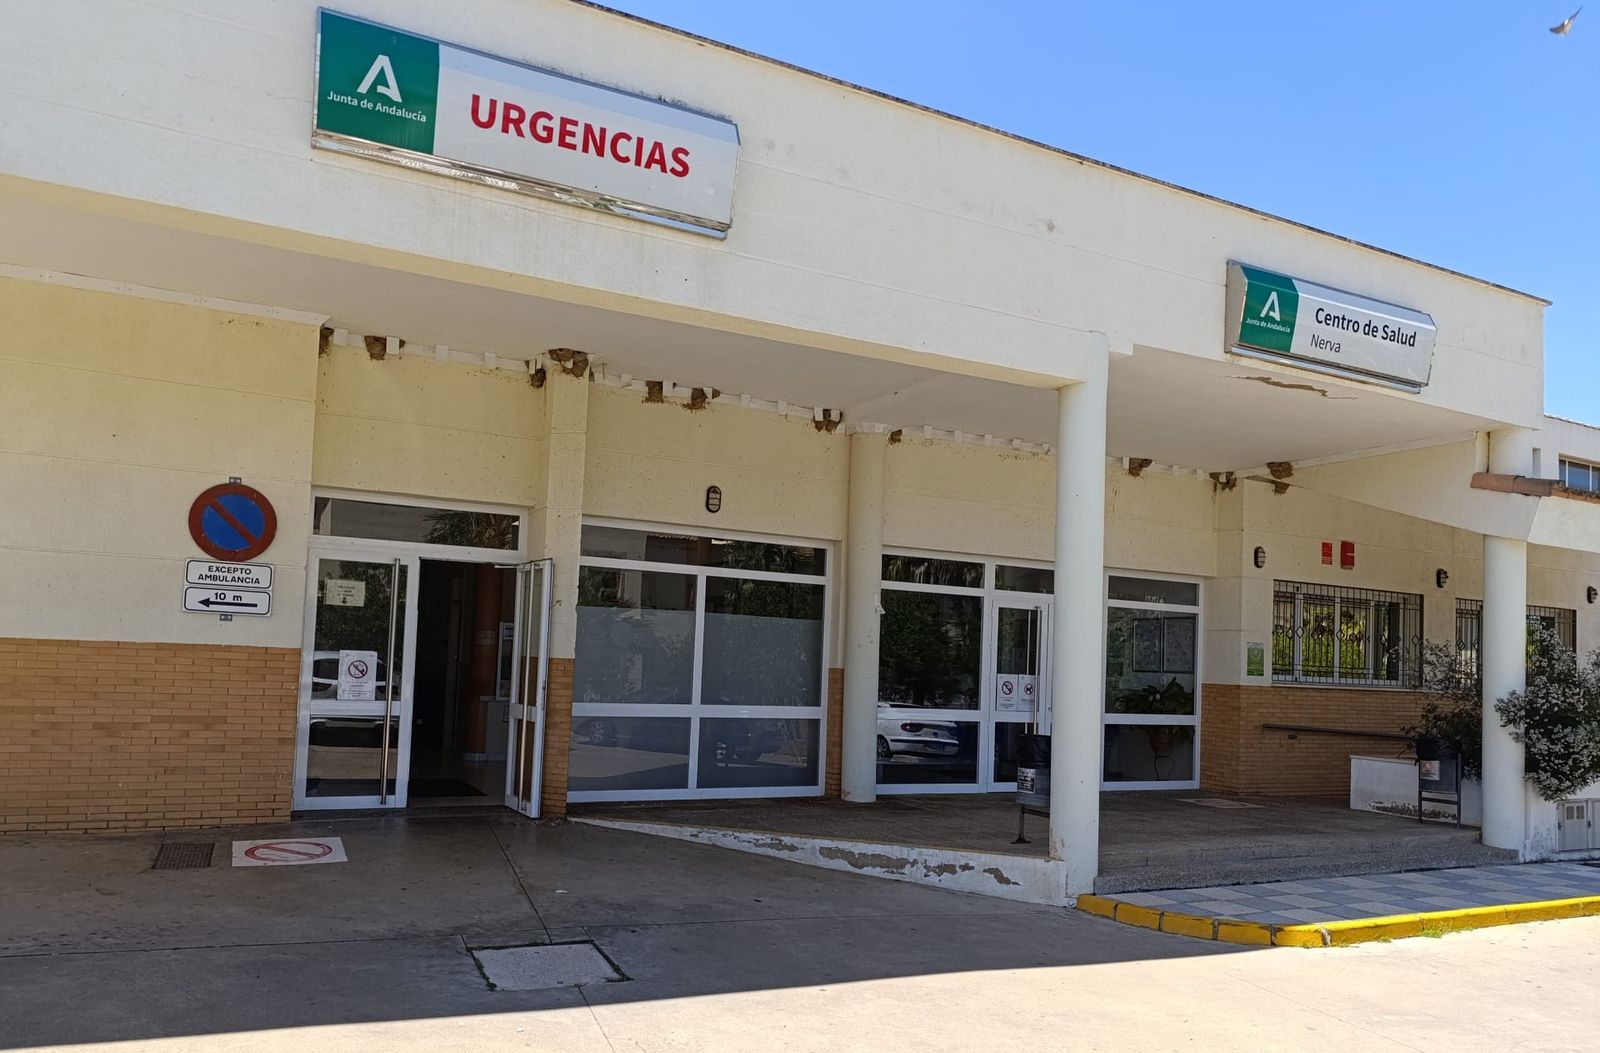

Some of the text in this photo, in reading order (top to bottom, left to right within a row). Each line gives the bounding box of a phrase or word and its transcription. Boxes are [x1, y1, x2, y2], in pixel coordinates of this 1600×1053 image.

[327, 91, 427, 122] Junta de Andalucía
[470, 93, 690, 178] URGENCIAS
[1245, 317, 1260, 326] Junta
[1260, 320, 1267, 328] de
[1315, 307, 1417, 348] Centro de Salud
[1310, 333, 1341, 353] Nerva
[208, 565, 252, 575] EXCEPTO
[197, 573, 260, 585] AMBULANCIA
[214, 592, 226, 601] 10
